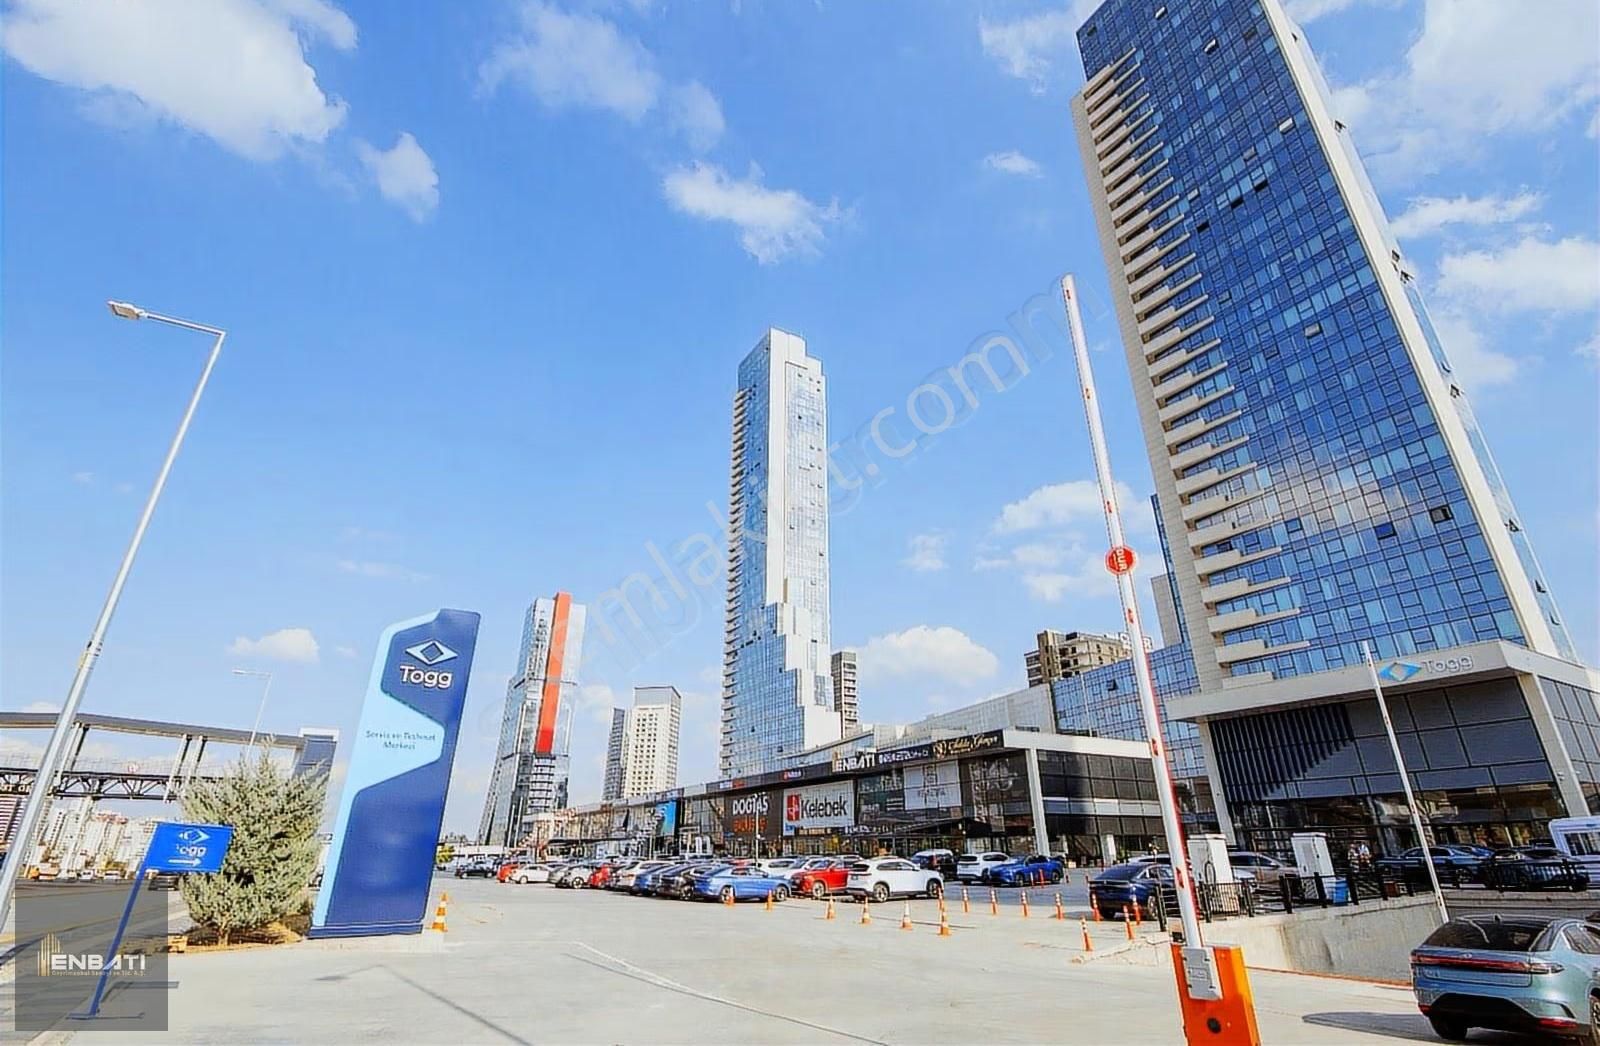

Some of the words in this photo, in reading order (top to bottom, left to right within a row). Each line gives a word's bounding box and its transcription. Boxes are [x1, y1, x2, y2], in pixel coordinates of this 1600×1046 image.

[1115, 548, 1128, 572] DUR
[1423, 655, 1474, 674] Togg
[399, 665, 453, 689] Togg
[800, 795, 848, 818] Kelebek
